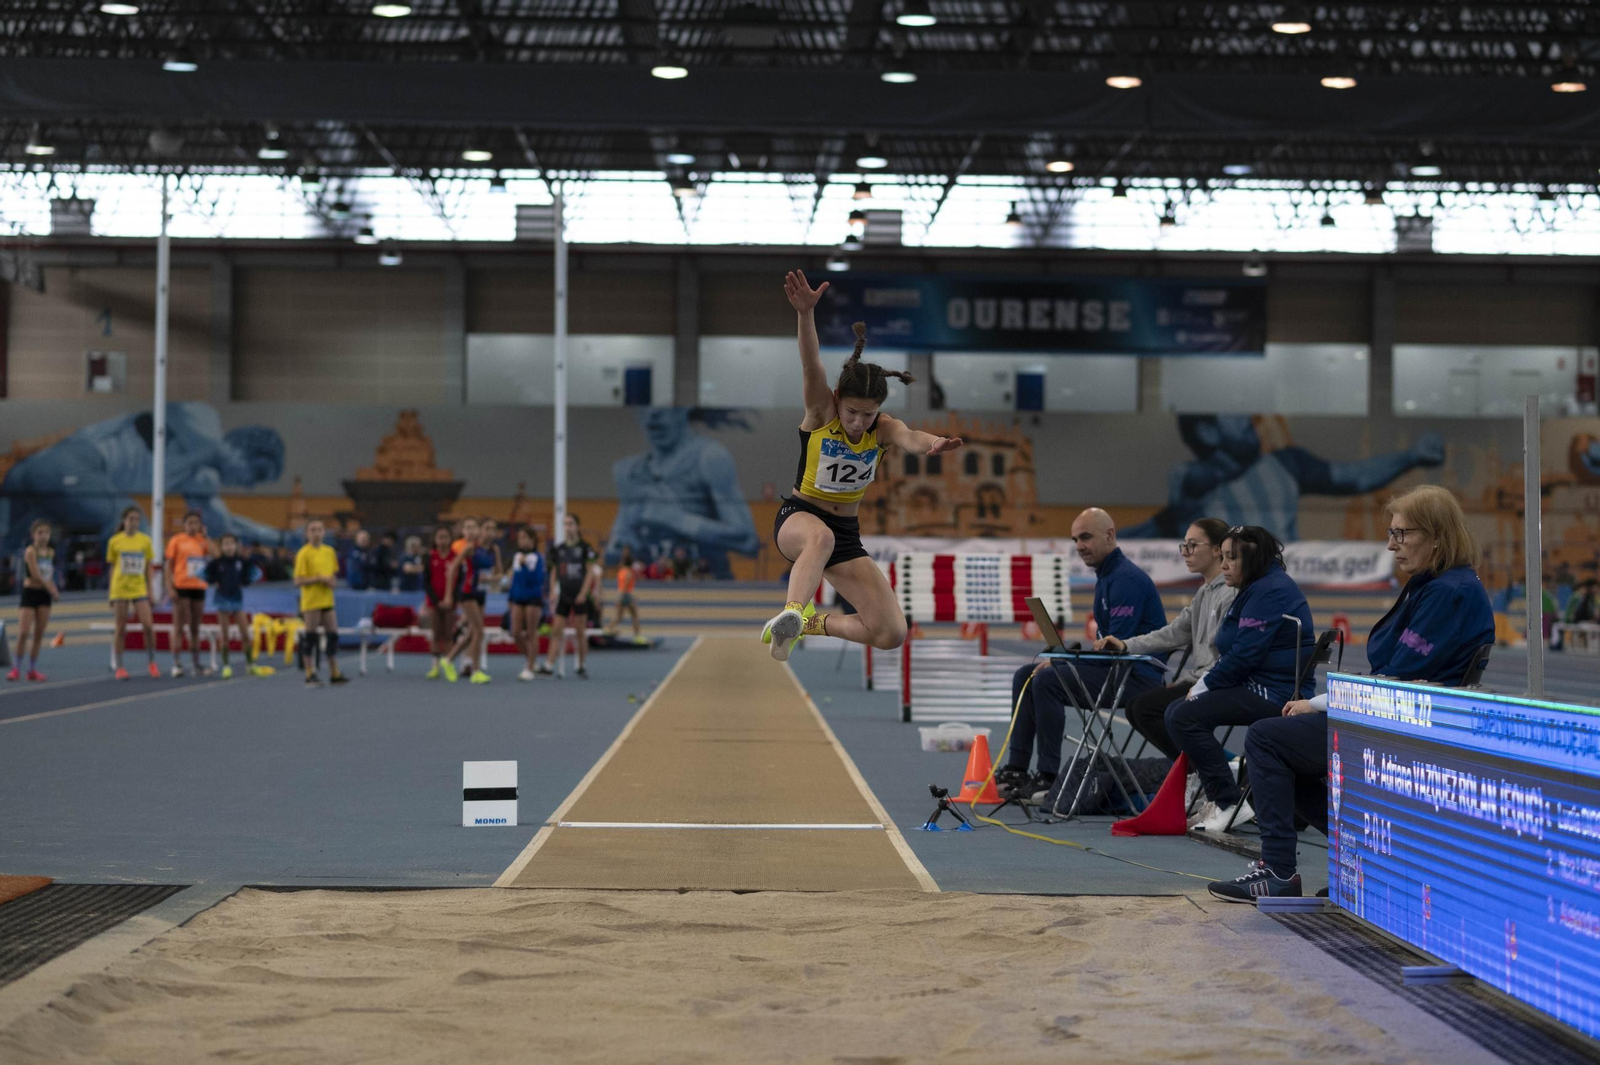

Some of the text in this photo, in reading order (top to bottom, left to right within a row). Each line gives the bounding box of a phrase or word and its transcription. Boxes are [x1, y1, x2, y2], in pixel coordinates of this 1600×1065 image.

[948, 299, 1130, 331] OURENSE
[826, 463, 873, 483] 124
[1363, 748, 1376, 785] 124
[1380, 752, 1412, 797] Adriana
[1412, 760, 1458, 813] VAZQUEZ
